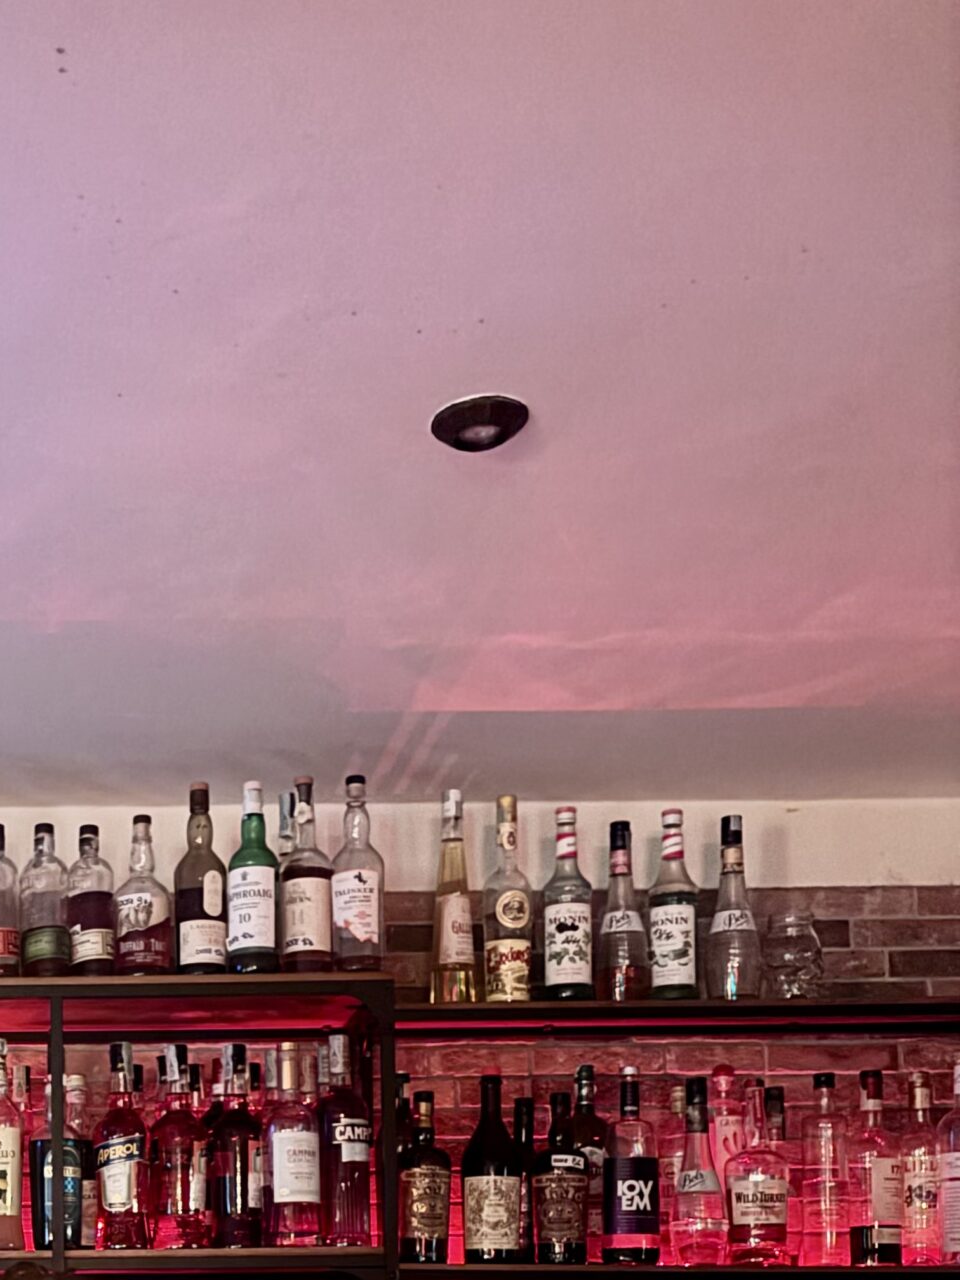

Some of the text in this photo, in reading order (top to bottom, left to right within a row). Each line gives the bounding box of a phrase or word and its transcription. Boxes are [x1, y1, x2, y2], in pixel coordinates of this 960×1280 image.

[335, 886, 375, 898] TALISKER
[238, 913, 252, 924] 10
[548, 914, 589, 925] MONIN
[96, 1142, 139, 1164] APEROL
[735, 1191, 759, 1204] WILD
